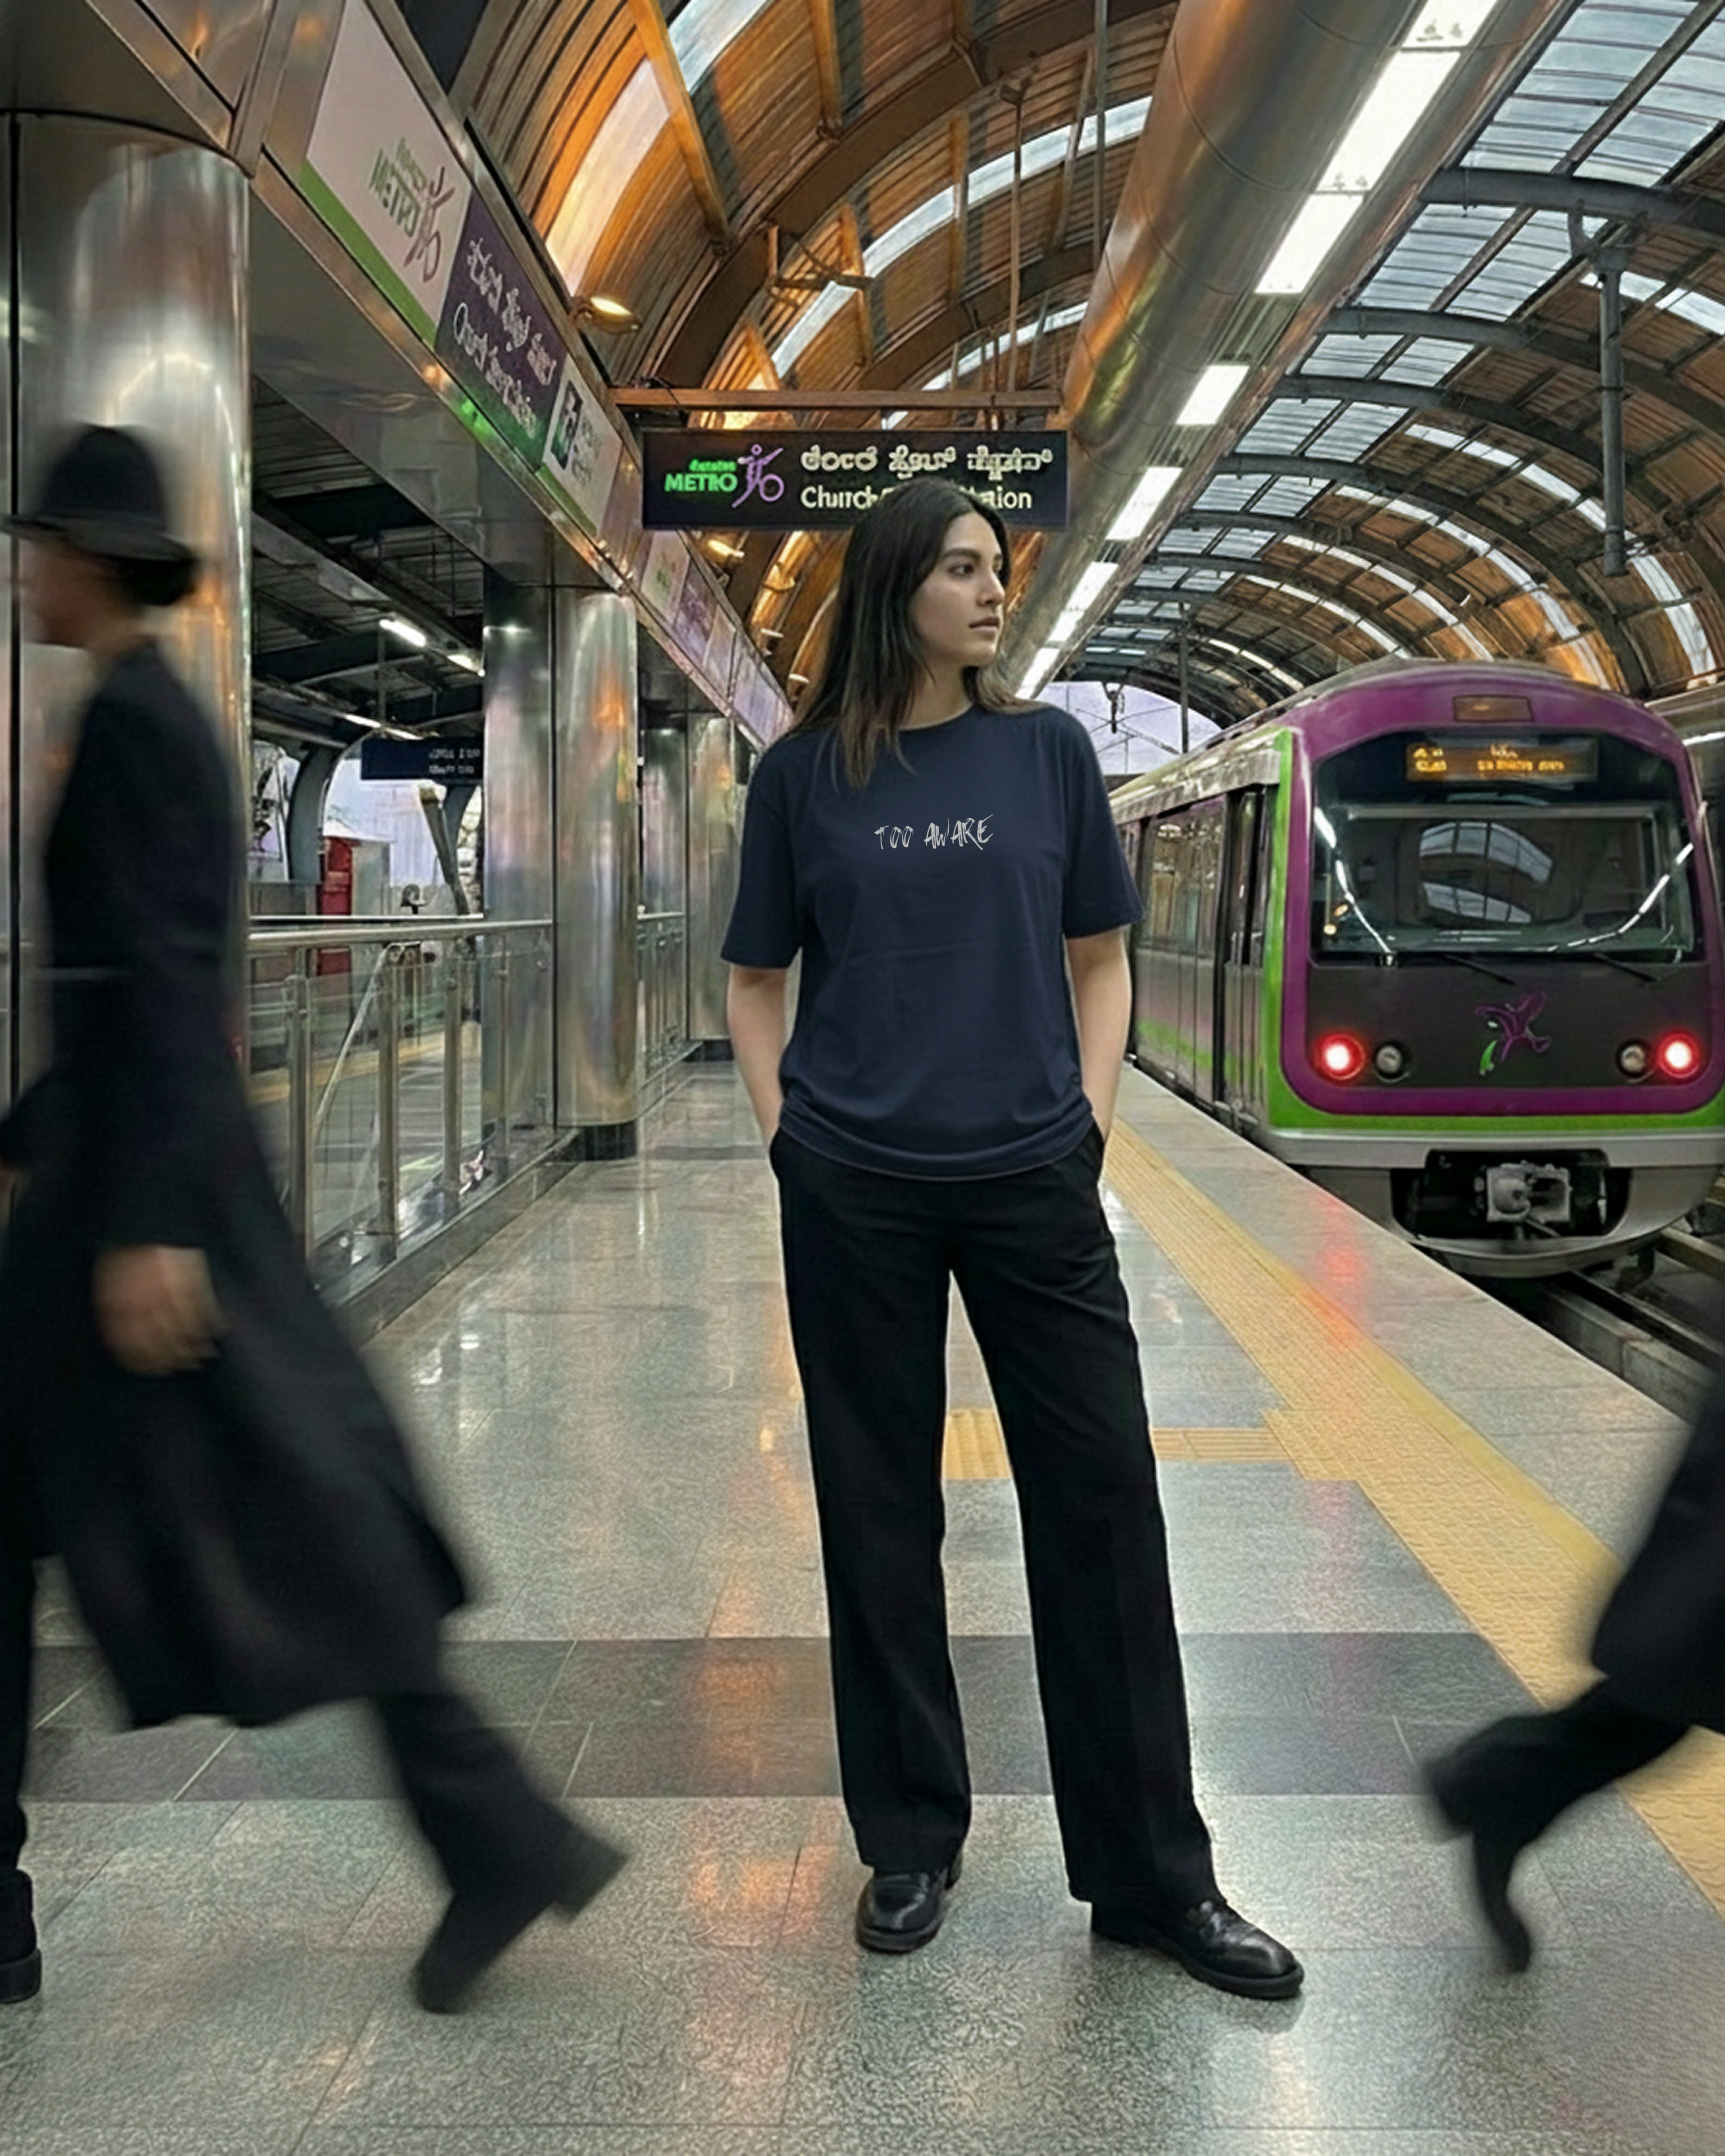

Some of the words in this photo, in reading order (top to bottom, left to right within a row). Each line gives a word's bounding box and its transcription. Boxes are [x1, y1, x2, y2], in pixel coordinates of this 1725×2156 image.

[665, 473, 738, 492] METRO
[874, 825, 914, 849] TOO
[924, 814, 993, 850] AWARE
